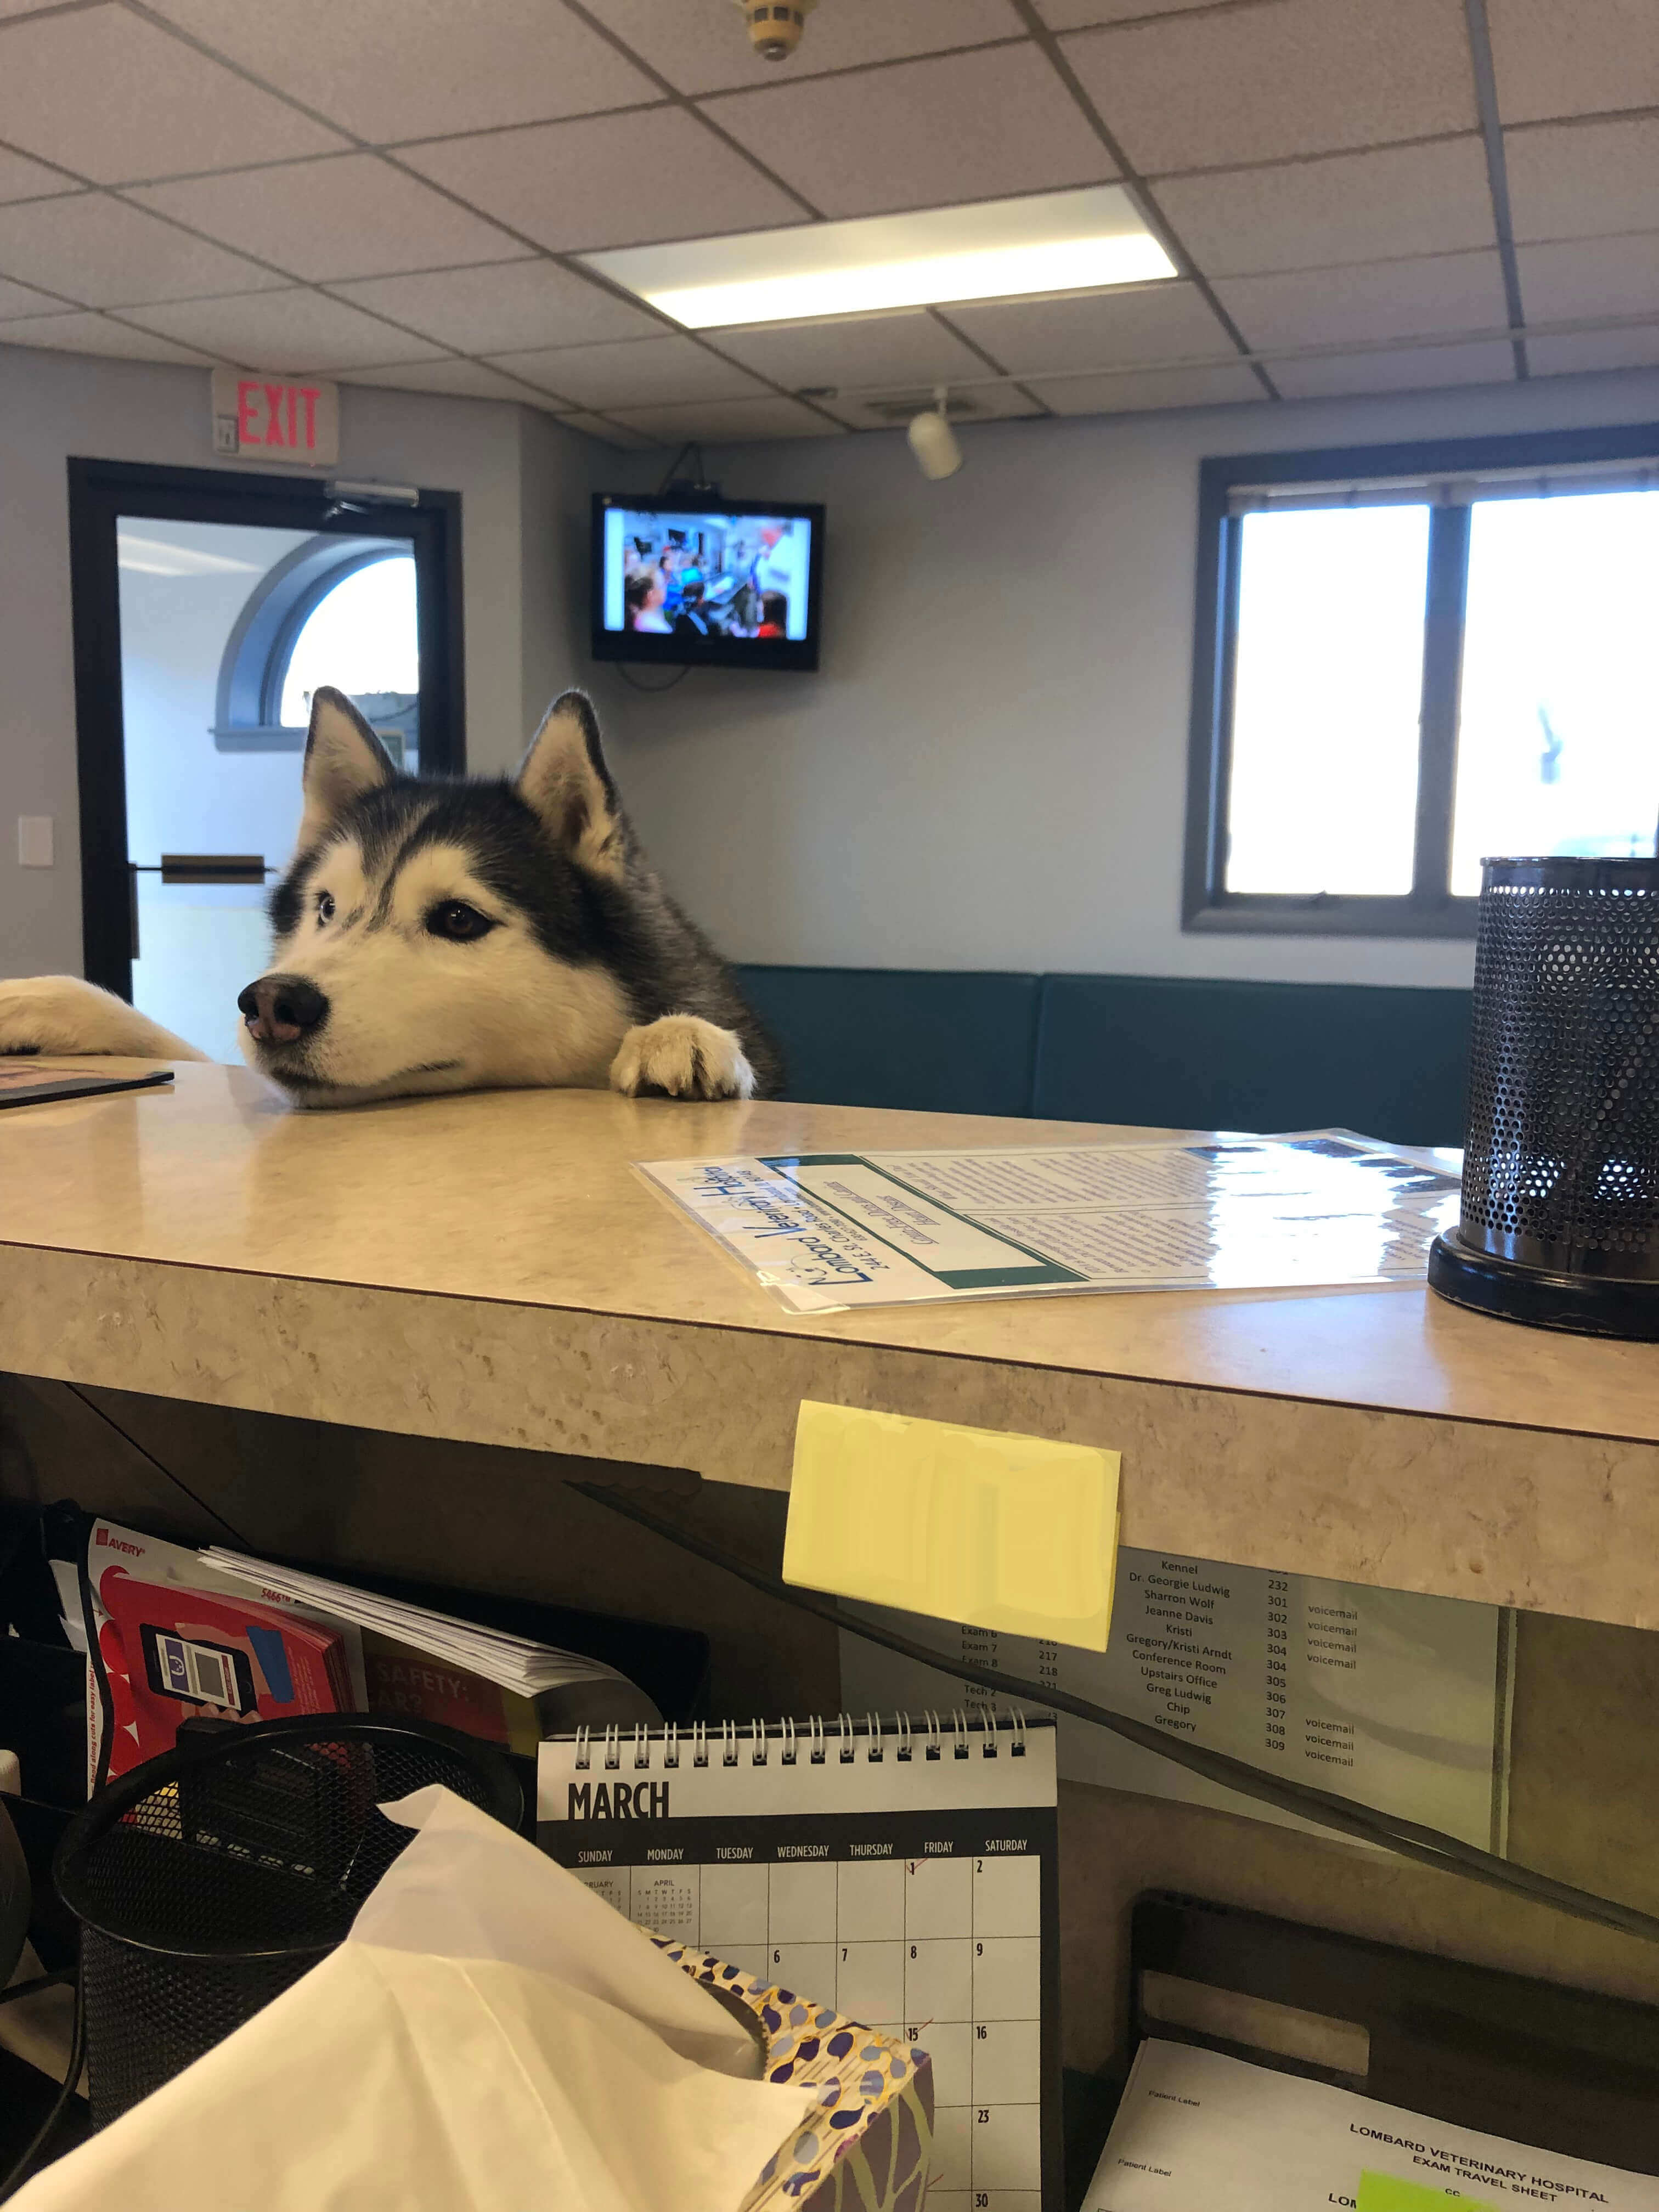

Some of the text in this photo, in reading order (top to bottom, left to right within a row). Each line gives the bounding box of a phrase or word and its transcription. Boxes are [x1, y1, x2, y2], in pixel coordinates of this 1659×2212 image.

[238, 381, 321, 449] EXIT
[693, 1166, 873, 1285] Lombard Veterinary Hospital
[791, 1209, 821, 1223] Road
[815, 1222, 850, 1243] Charles
[842, 1243, 863, 1251] St.
[859, 1257, 891, 1270] 244
[1161, 1561, 1288, 1592] Kennel 232
[1129, 1572, 1358, 1620] Dr. Georgie Ludwig 301 voicemail
[1144, 1590, 1357, 1637] Sharron Wolf 302 voicemail
[962, 1626, 988, 1637] Exam
[1145, 1606, 1357, 1653] Jeanne Davis 303 voicemail
[962, 1641, 1058, 1661] Exam 7 217
[1126, 1633, 1286, 1672] Gregory/Kristi Arndt 304
[1166, 1624, 1356, 1669] Kristi 304 voicemail
[962, 1656, 1058, 1676] Exam 8 218
[1132, 1650, 1286, 1688] Conference Room 305
[377, 1663, 469, 1702] SAFETY:
[964, 1685, 996, 1697] Tech 2
[1141, 1666, 1286, 1704] Upstairs Office 306
[370, 1691, 422, 1713] AR?
[964, 1700, 997, 1712] Tech 3
[1147, 1683, 1355, 1735] Greg Ludwig 307 voicemail
[1167, 1702, 1354, 1751] Chip 308 voicemail
[1155, 1715, 1353, 1767] Gregory 309 voicemail
[568, 1781, 669, 1820] MARCH
[578, 1839, 1028, 1863] SUNDAY MONDAY TUESDAY WEDNESDAY THURSDAY FRIDAY SATURDAY
[910, 1860, 983, 1876] 1 2
[774, 1943, 983, 1963] 6 7 8 9
[908, 2025, 988, 2041] 15 16
[1148, 2090, 1201, 2107] Patient Label
[978, 2109, 989, 2123] 23
[1118, 2158, 1172, 2177] Patient Label
[1350, 2123, 1609, 2203] LOMBARD VETERINARY HOSPITAL
[1413, 2155, 1558, 2202] EXAM TRAVEL SHEET
[975, 2193, 989, 2208] 30
